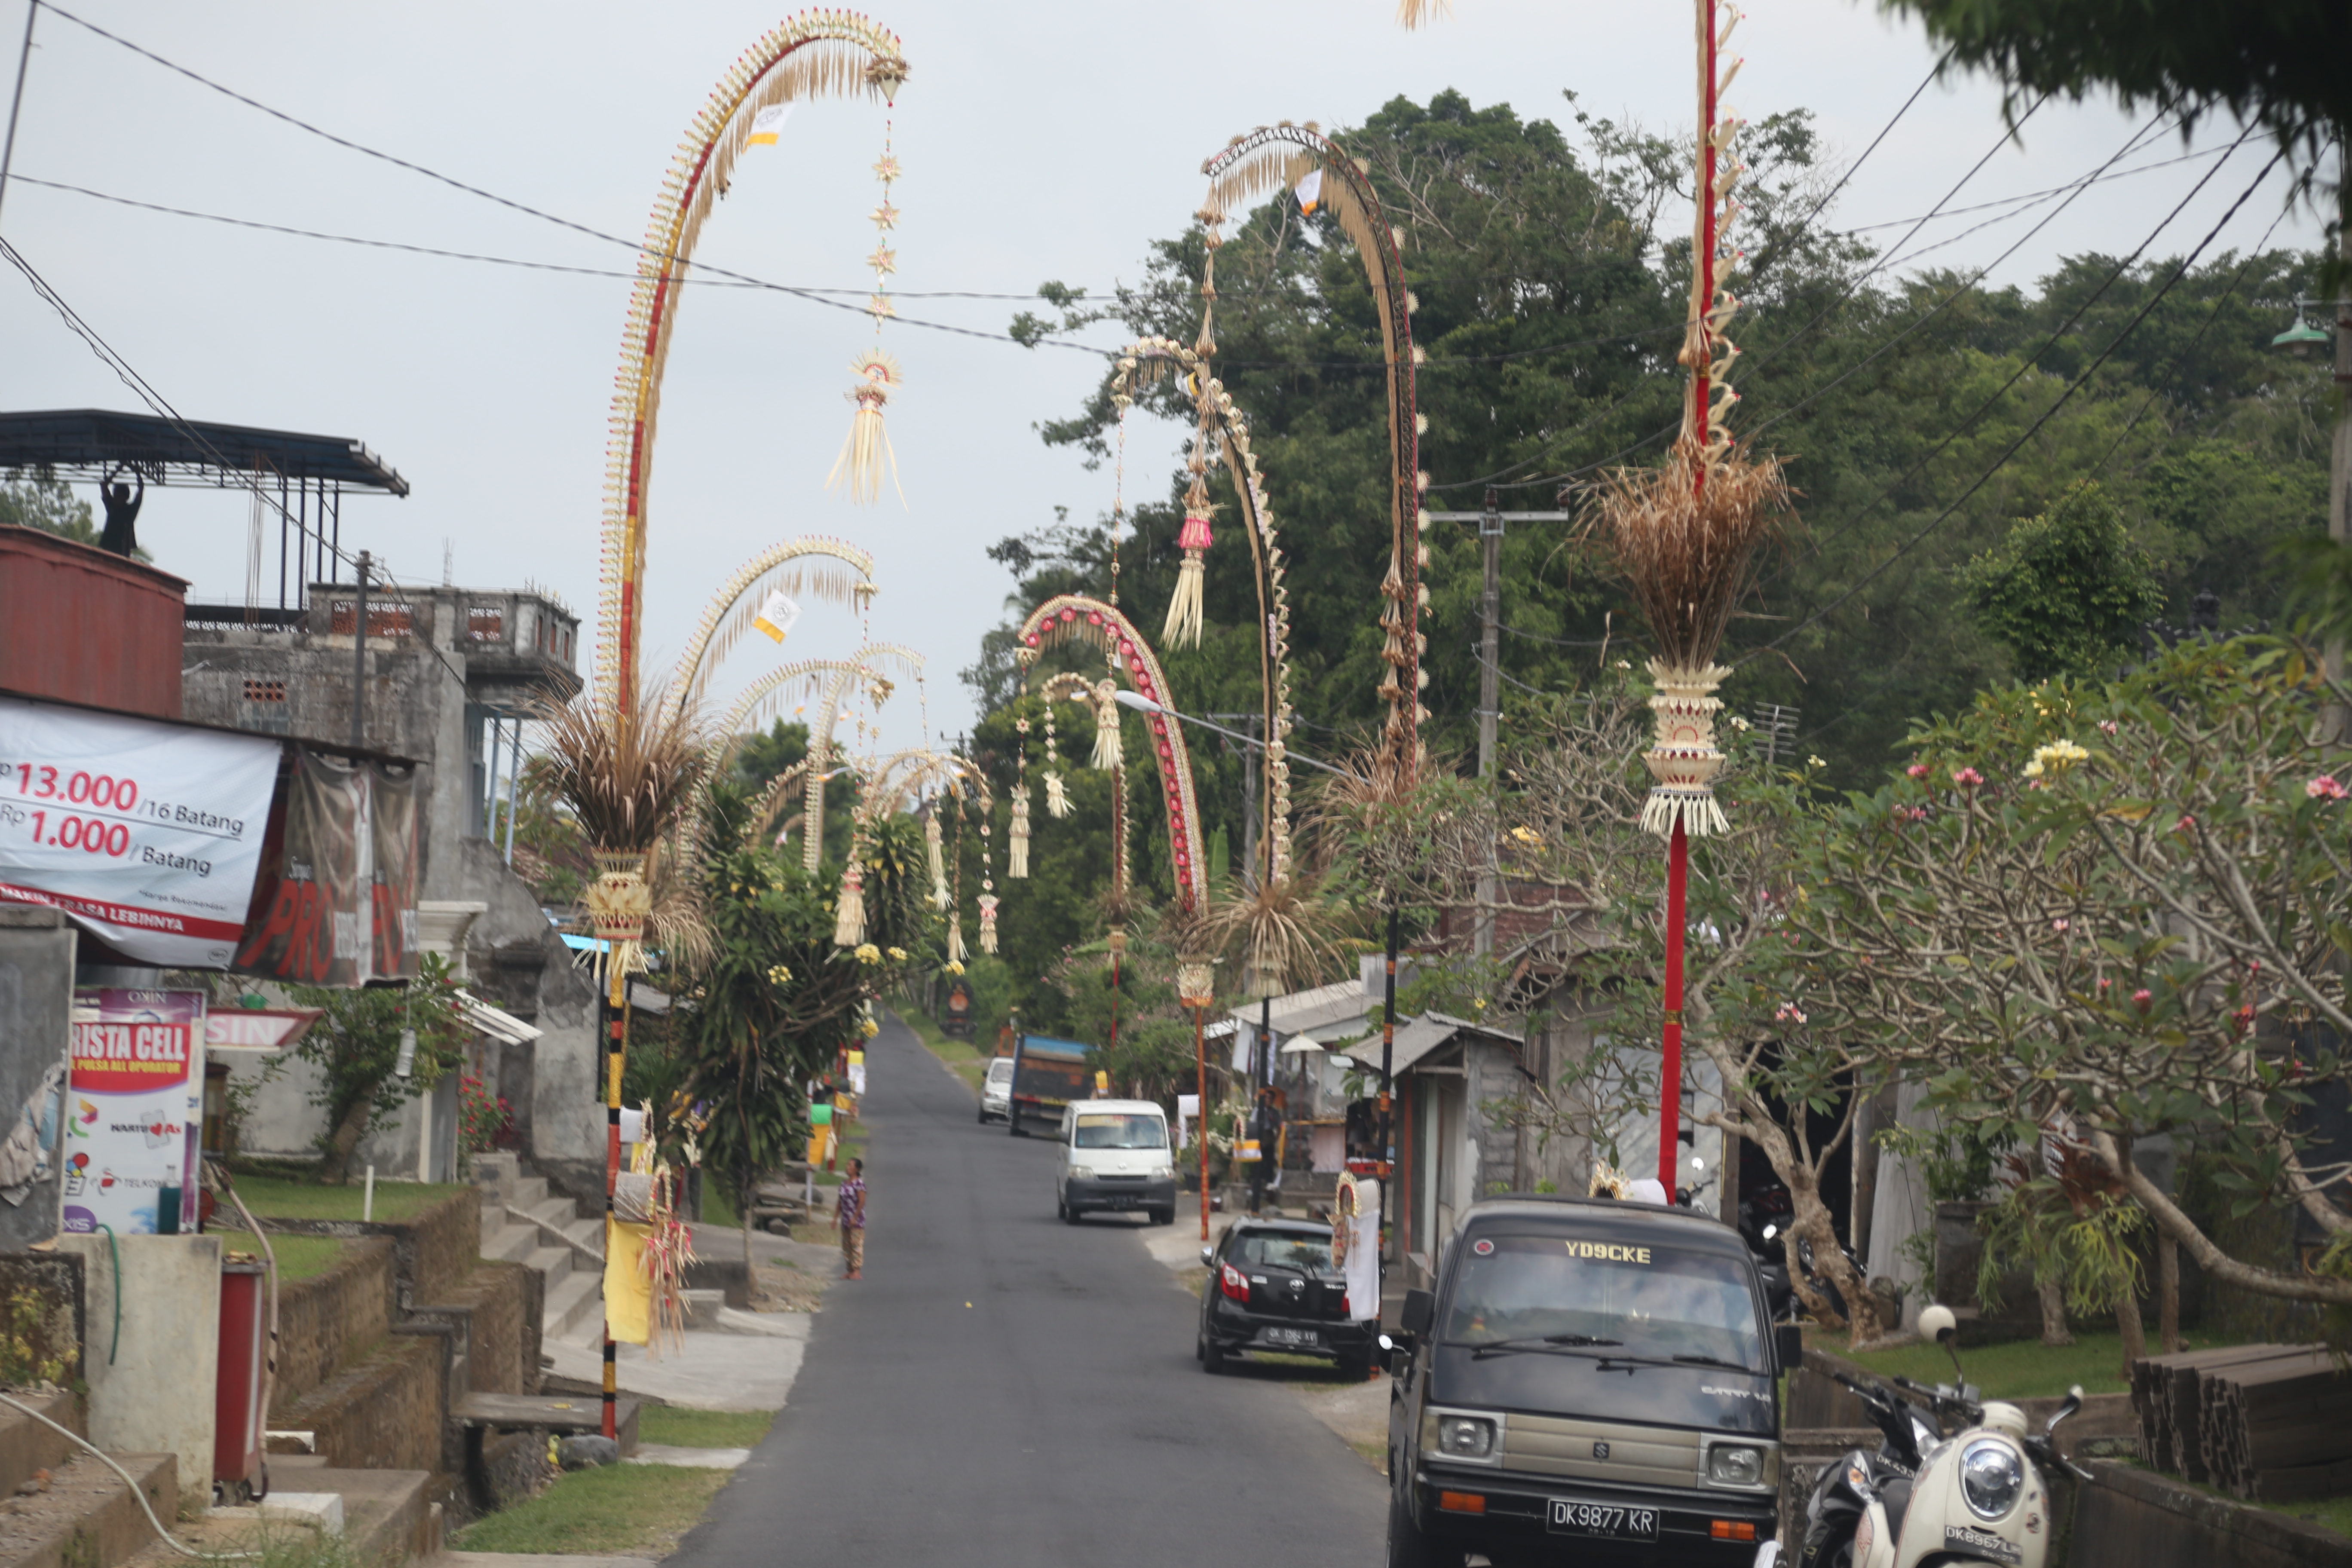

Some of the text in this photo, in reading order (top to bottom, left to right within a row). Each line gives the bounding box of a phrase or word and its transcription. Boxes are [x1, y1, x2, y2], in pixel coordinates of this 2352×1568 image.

[17, 762, 138, 812] 13.000
[175, 804, 244, 836] Batang
[0, 803, 24, 827] Rp
[31, 810, 129, 858] 1.000
[142, 845, 211, 878] Batang
[0, 886, 50, 903] MAKIN
[109, 907, 184, 932] LEBIHNYA
[237, 879, 334, 982] PRO
[78, 1059, 110, 1072] PULSA
[110, 1060, 128, 1073] ALL
[135, 1025, 185, 1061] CELL
[1629, 1509, 1653, 1533] KR
